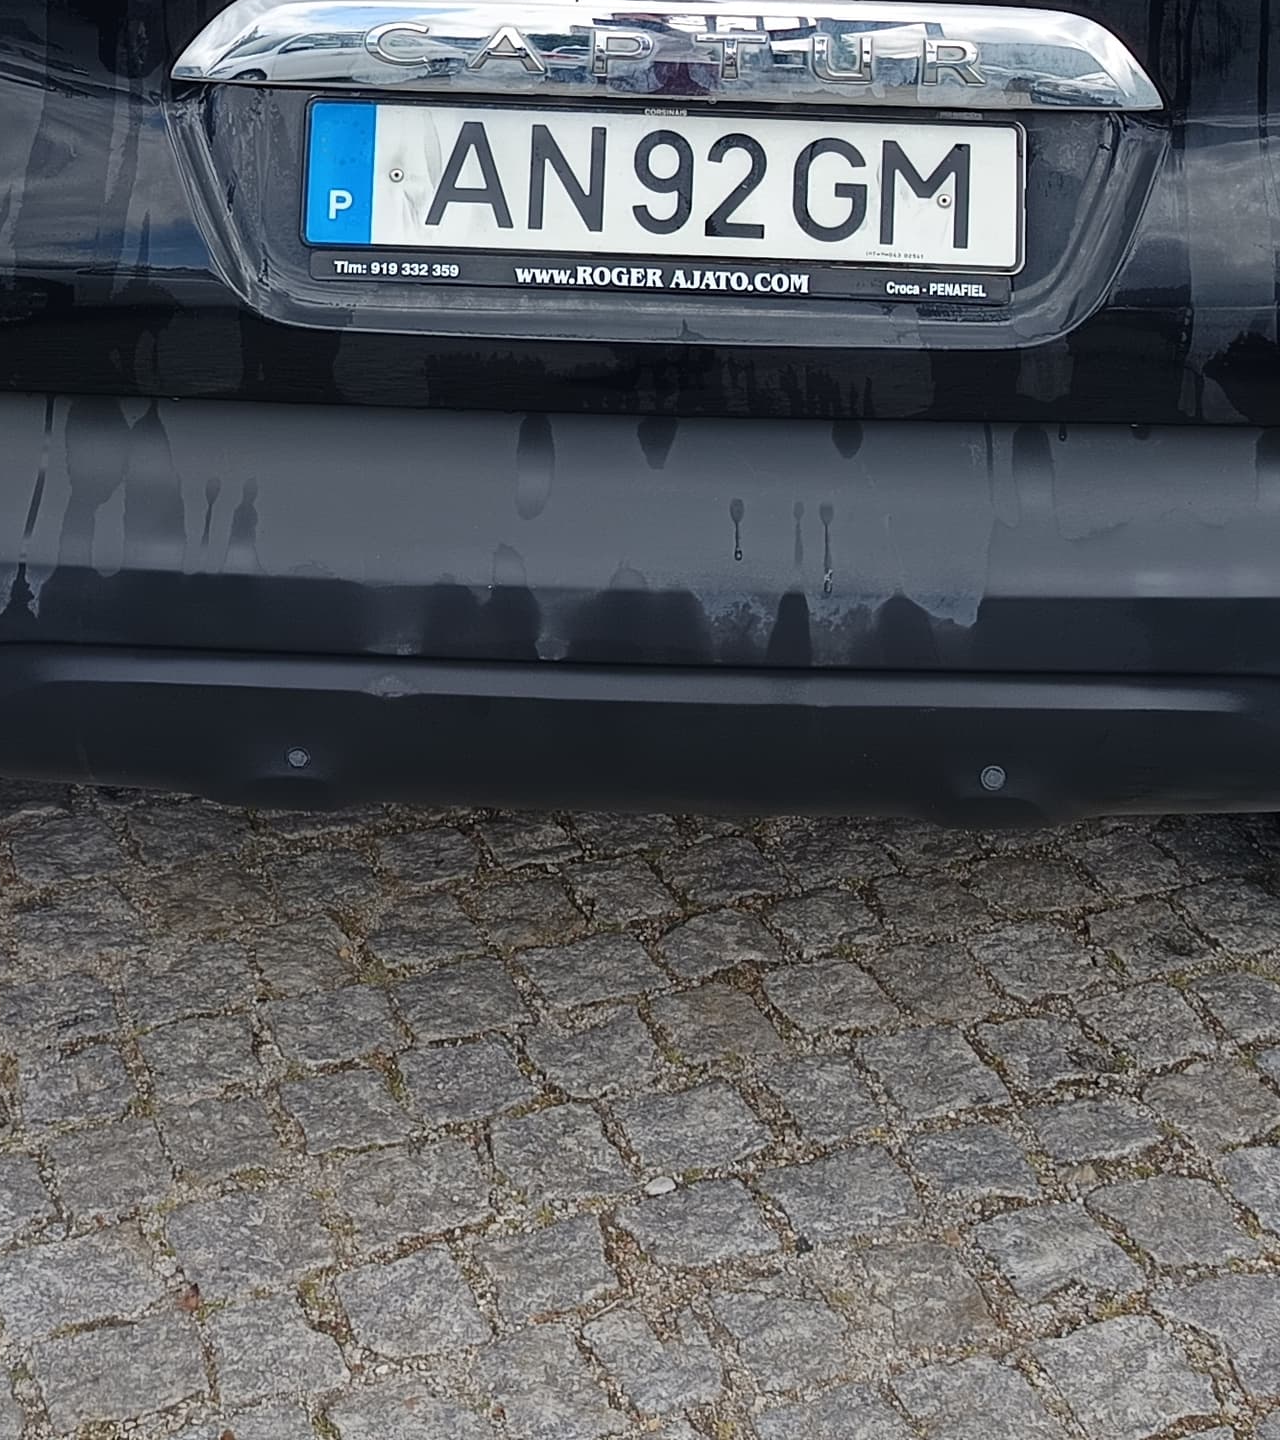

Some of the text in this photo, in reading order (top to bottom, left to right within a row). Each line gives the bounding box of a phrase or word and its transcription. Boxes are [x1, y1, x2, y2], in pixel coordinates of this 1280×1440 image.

[363, 21, 987, 86] CAPTUR
[328, 189, 353, 220] P
[370, 262, 398, 275] 919
[401, 263, 429, 276] 332
[432, 264, 459, 277] 359
[514, 265, 810, 294] www.ROGER AJATO.COM
[886, 281, 920, 295] Croca
[929, 282, 987, 298] PENAFIEL
